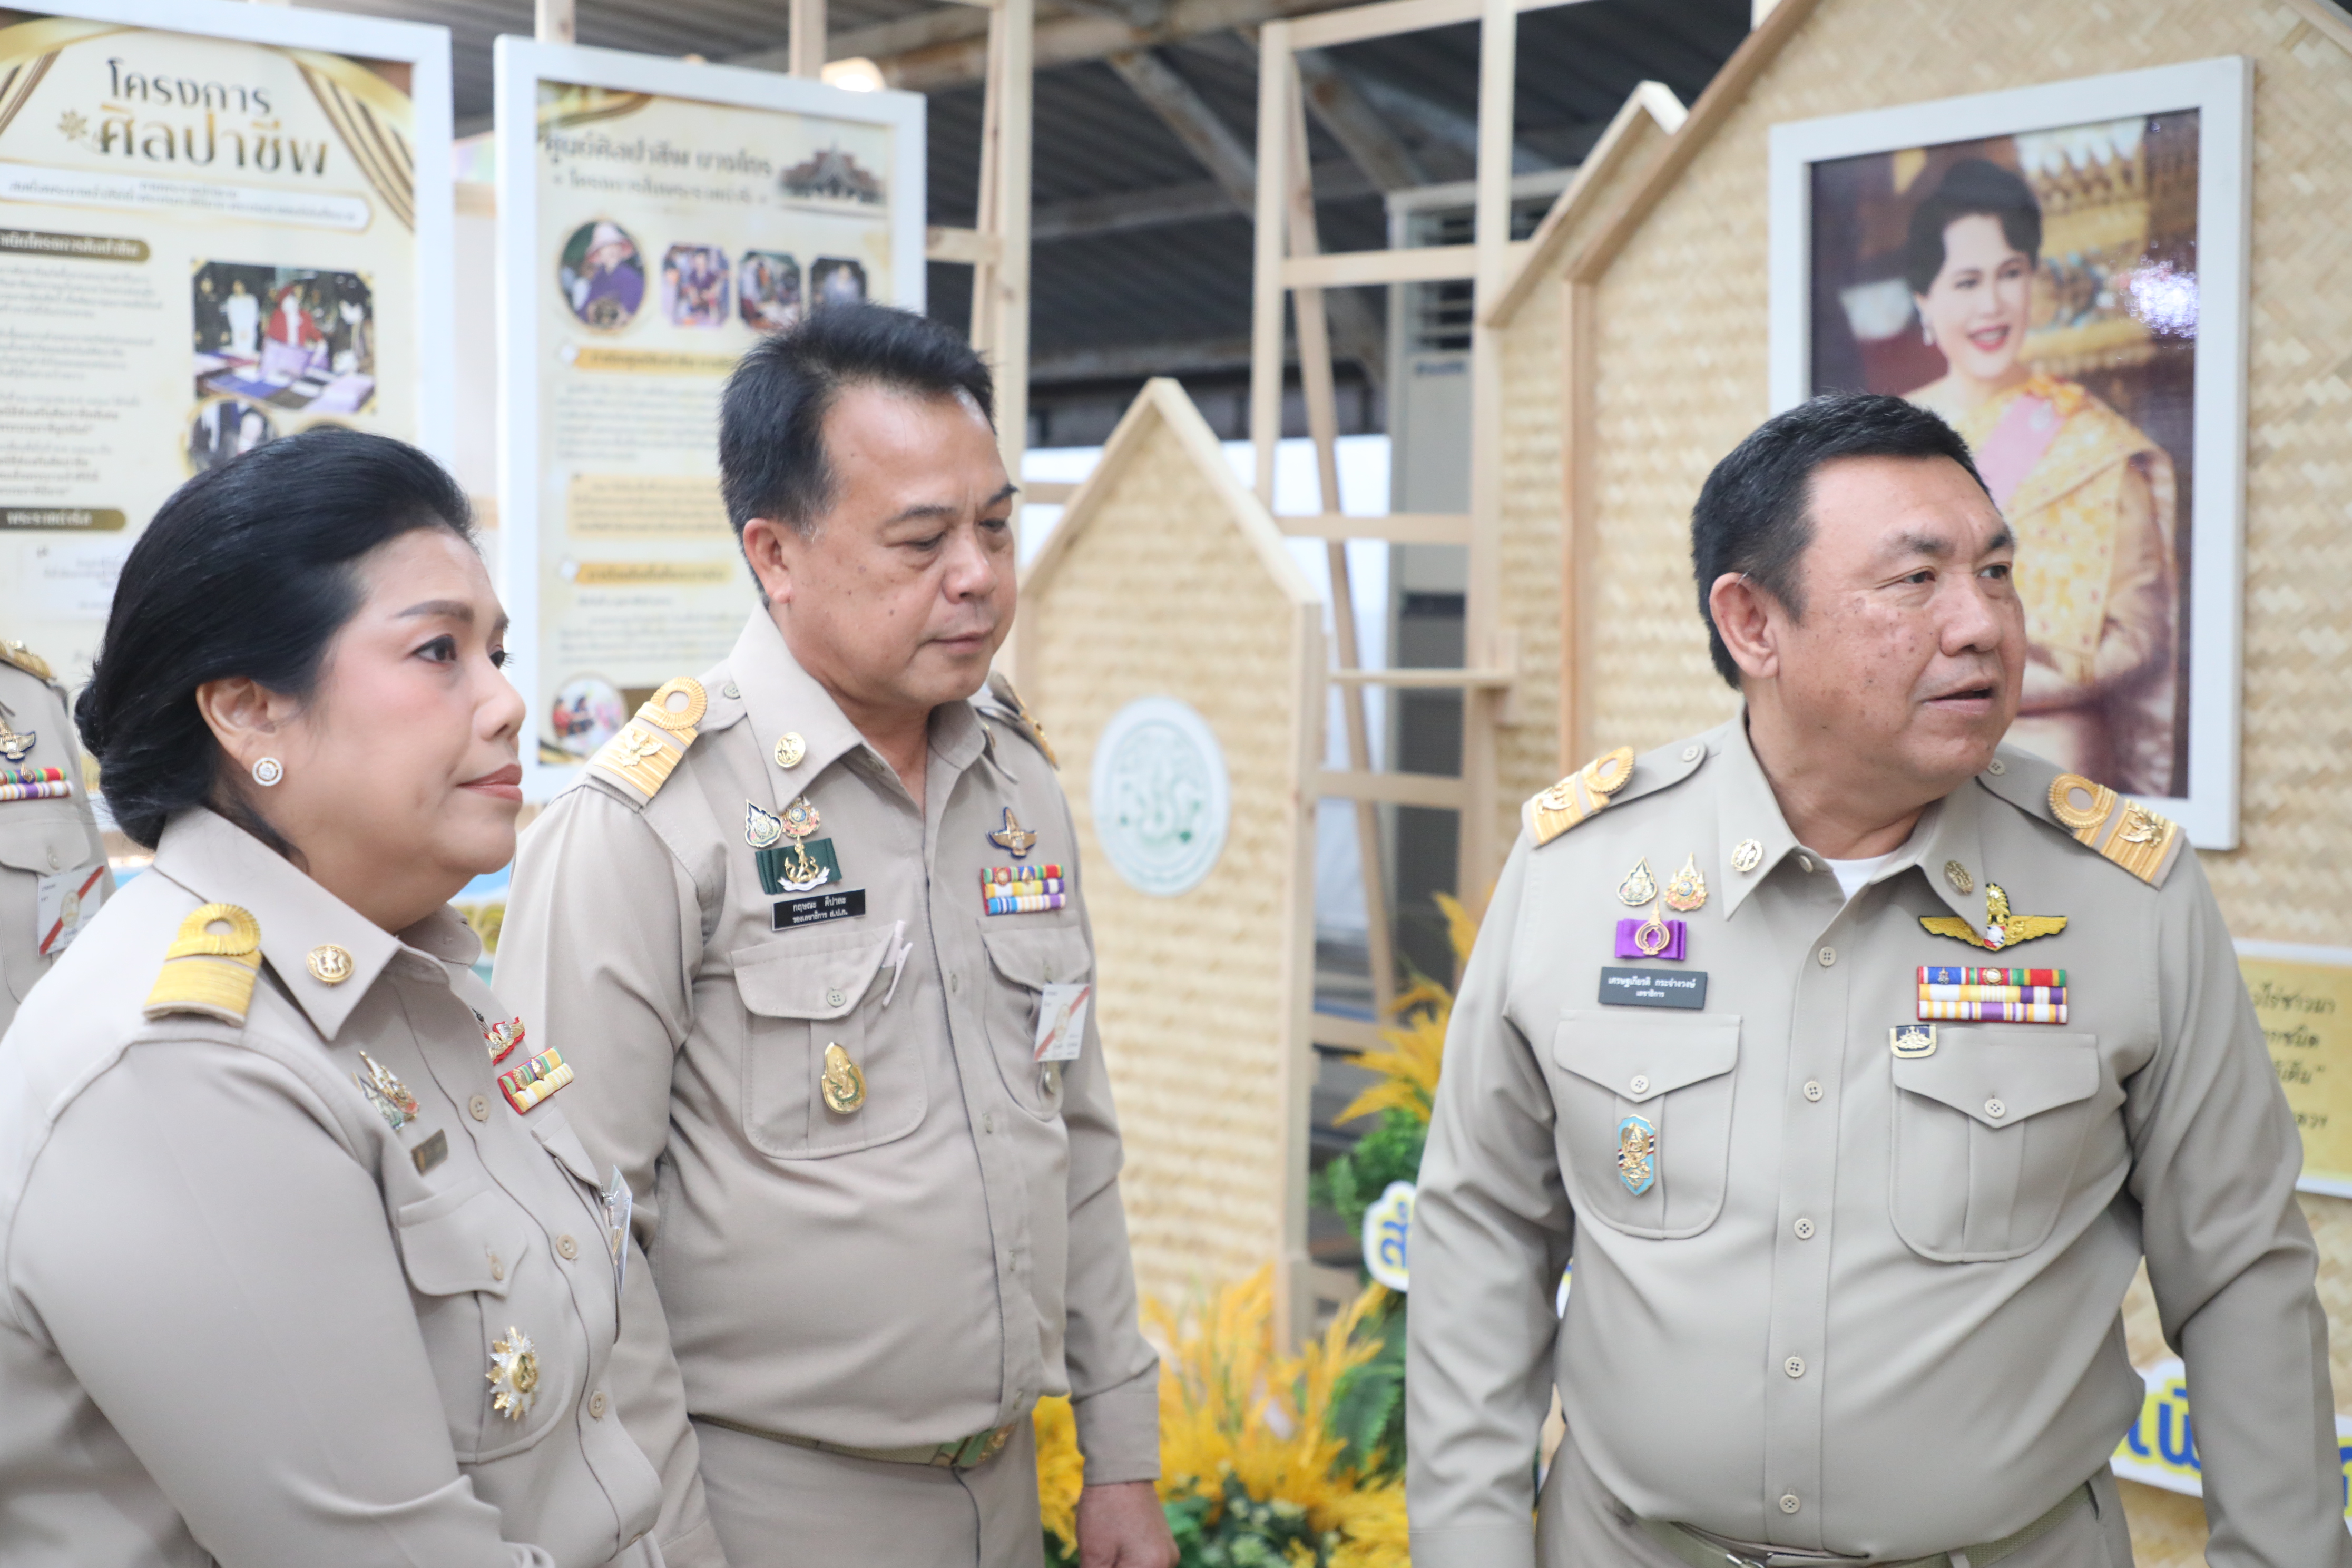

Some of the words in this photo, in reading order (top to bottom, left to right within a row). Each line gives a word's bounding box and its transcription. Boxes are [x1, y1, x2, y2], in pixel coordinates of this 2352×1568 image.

[106, 57, 271, 115] โครงการ
[100, 102, 328, 176] ศิลปาชีพ
[793, 901, 816, 912] กฤษณะ
[793, 910, 827, 923] รองเลขาธิการ
